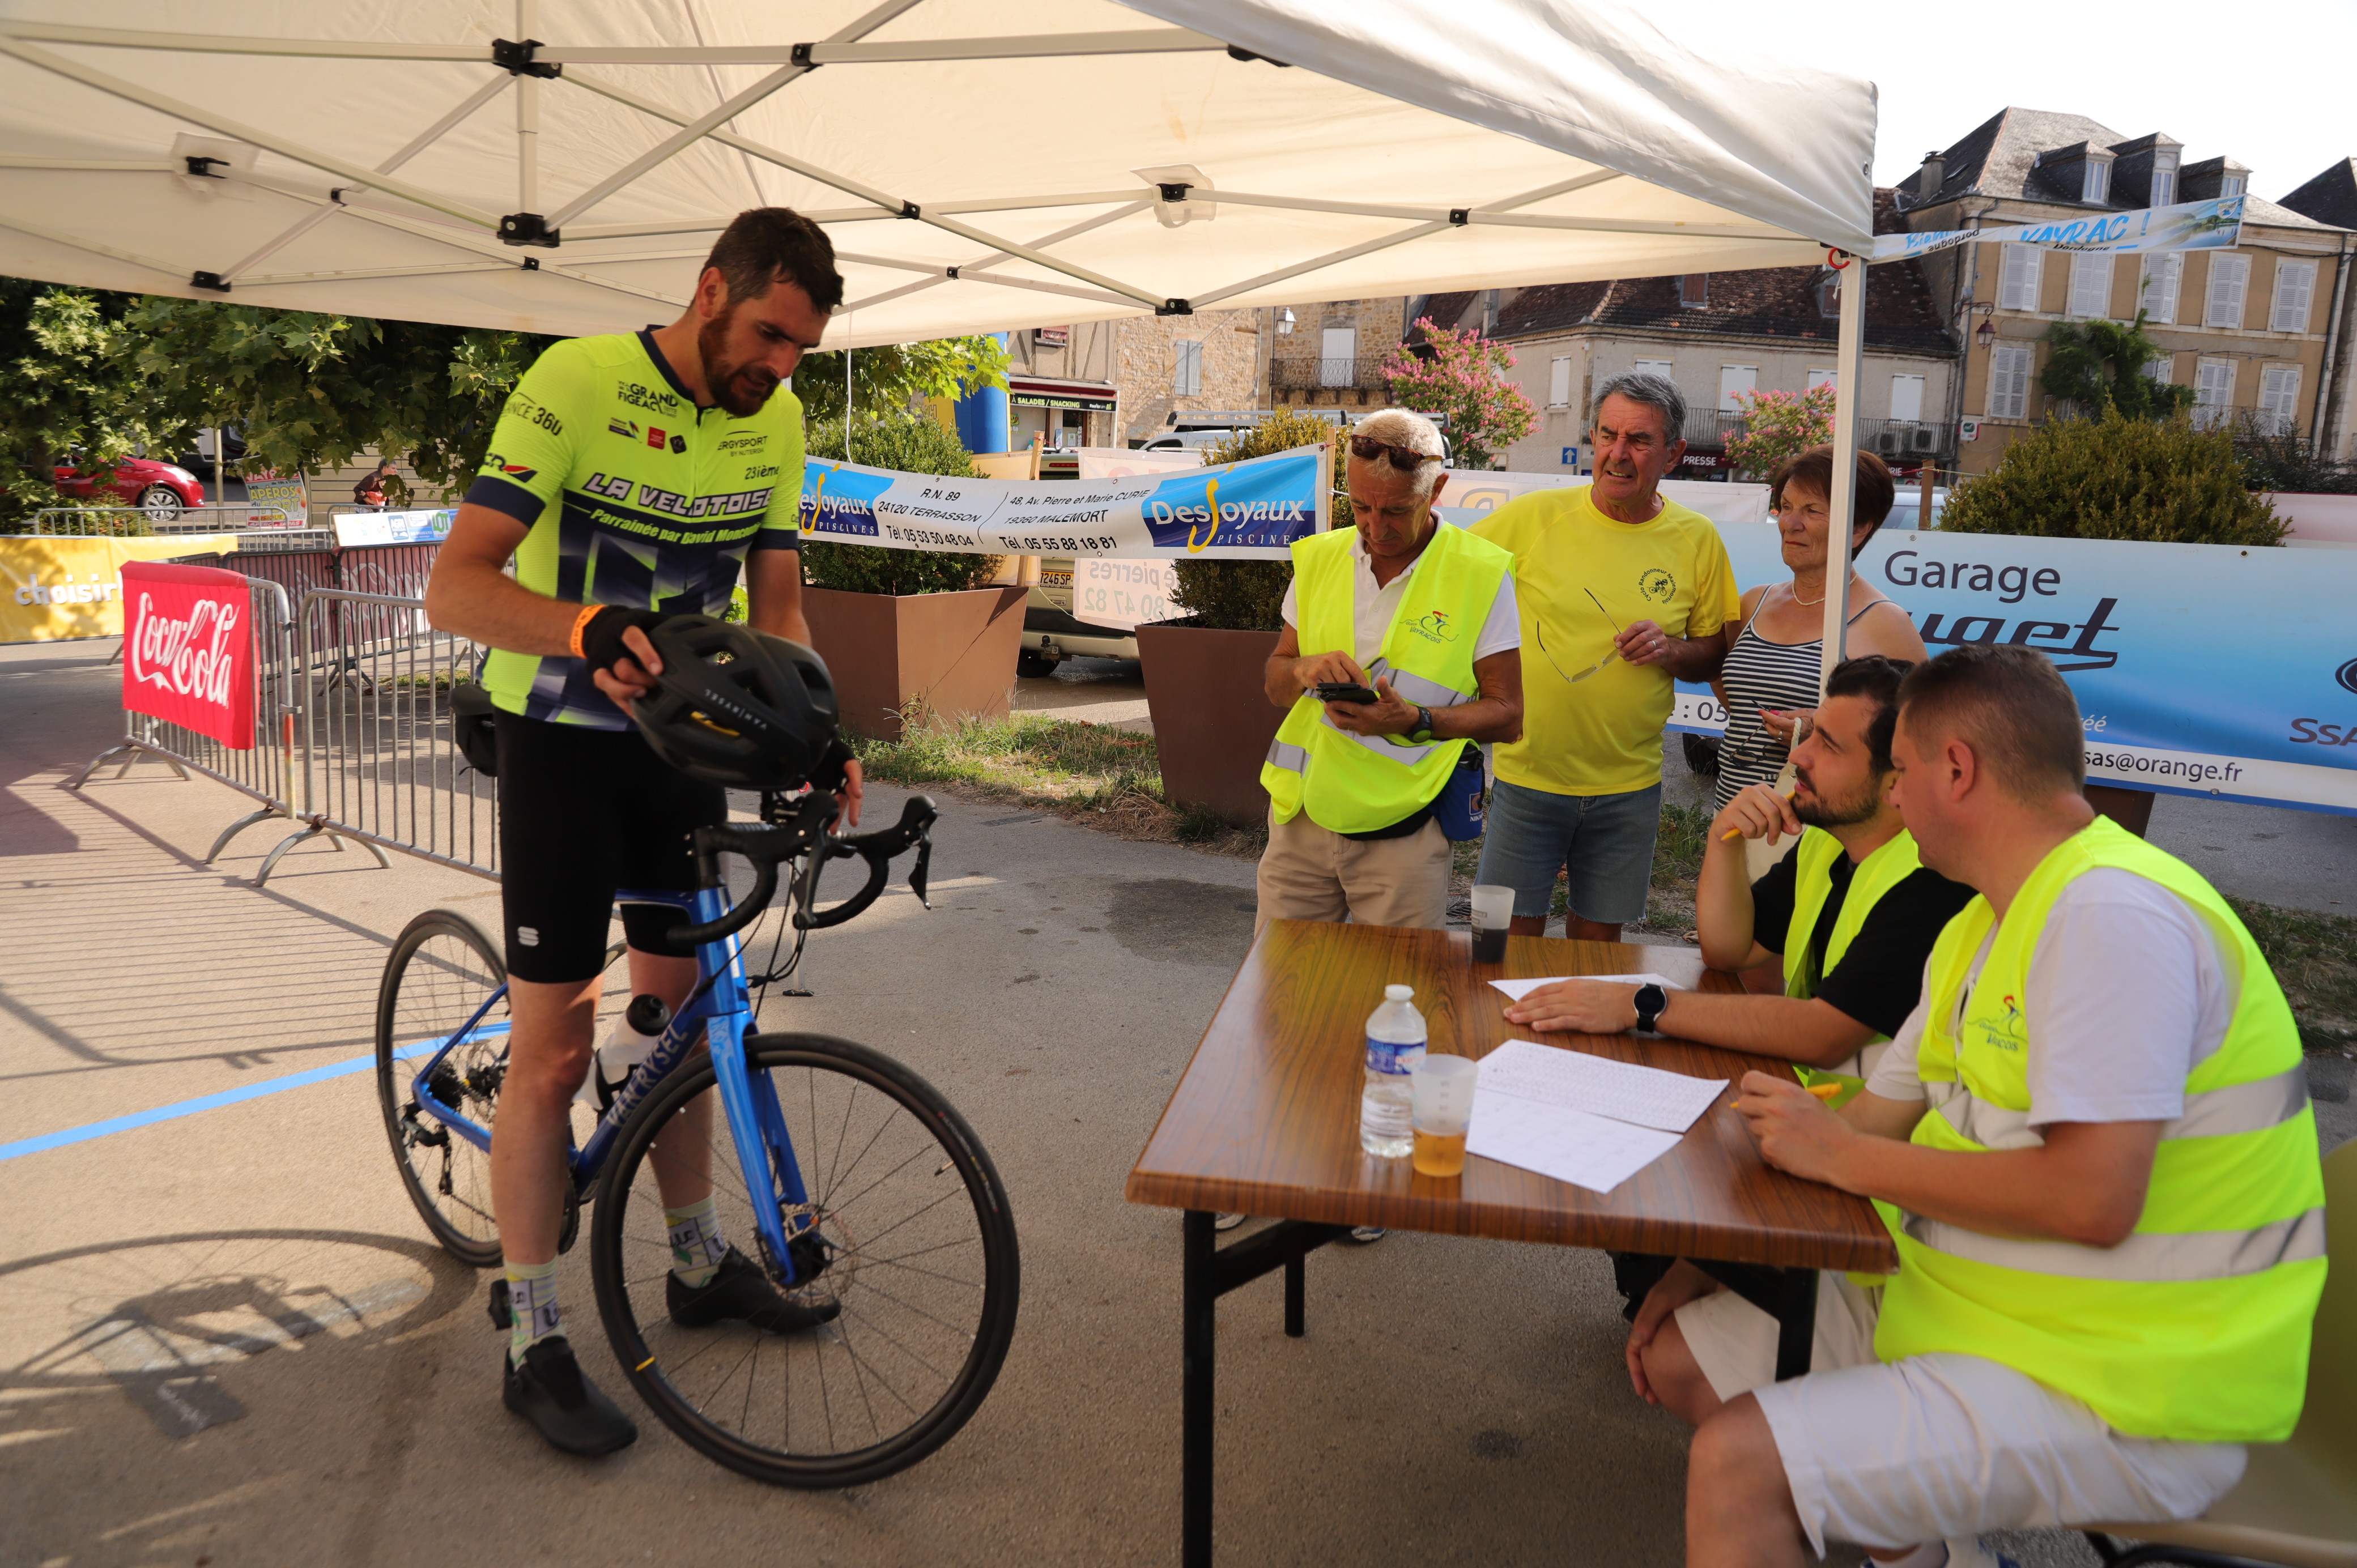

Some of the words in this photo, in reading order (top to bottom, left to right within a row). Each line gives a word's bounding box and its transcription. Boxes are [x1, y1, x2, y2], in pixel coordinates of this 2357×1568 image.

[618, 391, 657, 412] FIGEAC
[630, 383, 679, 407] GRAND
[1018, 397, 1045, 406] SALADES
[1050, 400, 1080, 408] SNACKING
[533, 407, 563, 436] 360
[717, 436, 768, 450] ERGYSPORT
[1682, 455, 1716, 466] PRESSE
[250, 485, 297, 501] APÉROS
[582, 472, 635, 501] LA
[920, 488, 943, 499] R.N.
[945, 492, 960, 501] 89
[261, 498, 300, 514] FORT
[1010, 496, 1023, 506] 48,
[1025, 496, 1039, 505] Av.
[1043, 496, 1071, 505] Pierre
[1084, 493, 1113, 504] Marie
[1115, 489, 1151, 501] CURIE
[878, 501, 909, 514] 24120
[909, 506, 982, 522] TERRASSON
[1037, 509, 1109, 523] MALEMORT
[432, 512, 449, 532] LOT
[590, 508, 660, 537] Parrainée
[658, 529, 682, 542] par
[680, 531, 718, 544] David
[819, 522, 874, 534] PISCINES
[886, 525, 903, 540] Tél.
[904, 529, 917, 542] 05
[917, 530, 929, 543] 53
[929, 532, 944, 544] 50
[944, 534, 958, 546] 48
[958, 535, 974, 546] 04
[999, 536, 1024, 549] Tél.
[1024, 538, 1041, 549] 05
[1043, 538, 1060, 550] 55
[1061, 538, 1078, 551] 88
[1079, 537, 1099, 549] 18
[1099, 536, 1117, 548] 81
[1639, 568, 1667, 585] Randonneur
[1885, 551, 2061, 603] Garage
[1640, 587, 1652, 601] Cyclo
[1662, 573, 1676, 604] Malemortois
[1697, 702, 1729, 722] 05
[637, 1024, 688, 1089] RYSEL
